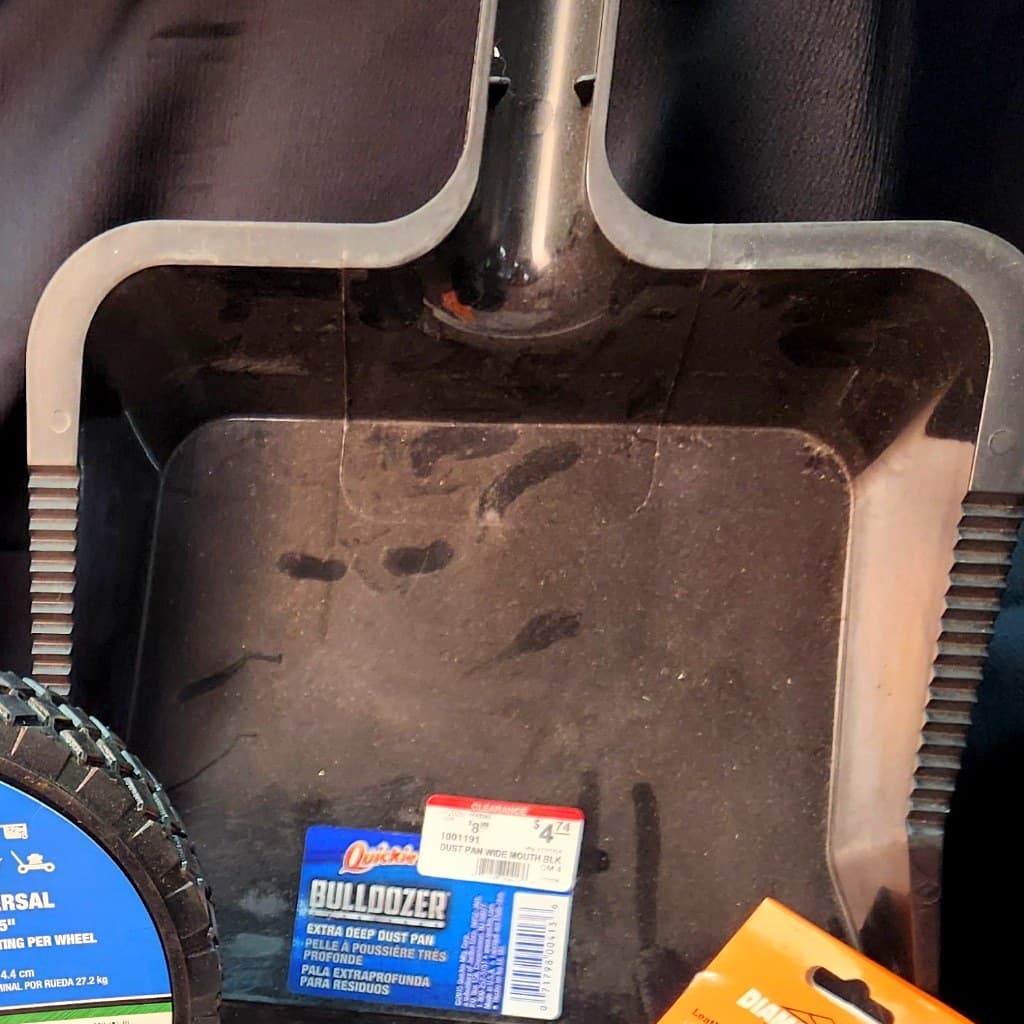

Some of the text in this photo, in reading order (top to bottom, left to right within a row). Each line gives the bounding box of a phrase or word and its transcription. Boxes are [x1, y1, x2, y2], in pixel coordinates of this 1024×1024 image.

[440, 842, 561, 864] DUST PAN WIDE MOUTH BLK
[309, 879, 447, 920] BULLDOZER
[28, 935, 52, 948] PER
[54, 932, 98, 945] WHEEL
[306, 923, 435, 946] EXTRA DEEP DUST PAN
[305, 938, 338, 951] PELLE
[303, 951, 364, 966] PROFONDE
[0, 970, 16, 979] 4.4
[19, 969, 34, 978] cm
[301, 965, 431, 987] PALA EXTRAPROFUNDA
[25, 980, 42, 991] POR
[44, 978, 74, 989] RUEDA
[76, 976, 95, 986] 27.2
[97, 976, 108, 986] kg
[299, 976, 330, 989] PARA
